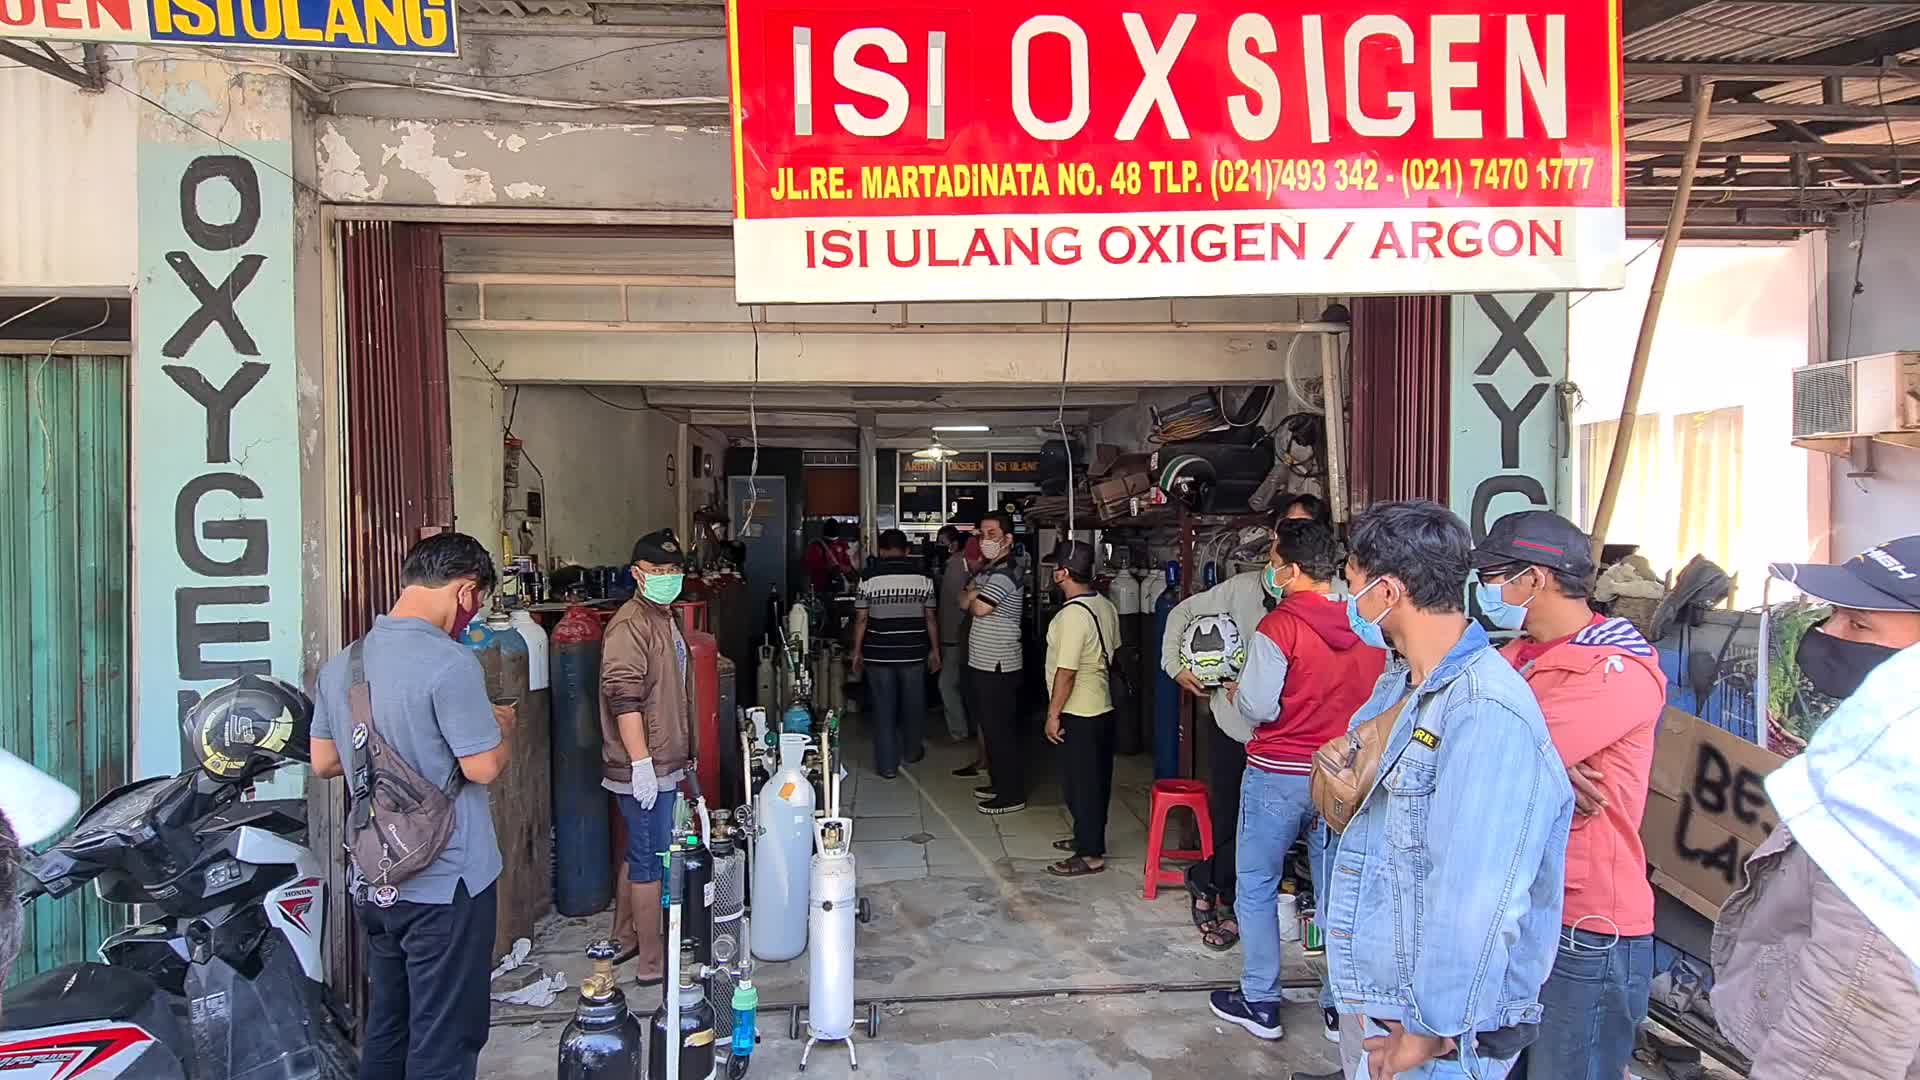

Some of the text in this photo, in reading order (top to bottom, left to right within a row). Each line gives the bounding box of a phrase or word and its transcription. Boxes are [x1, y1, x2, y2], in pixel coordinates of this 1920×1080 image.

[793, 26, 946, 140] ISI
[770, 166, 854, 200] JL.RE.
[862, 164, 1051, 198] MARTADINATA
[1058, 162, 1104, 195] NO.
[1111, 162, 1141, 194] 48
[1149, 160, 1202, 193] TLP.
[1335, 158, 1380, 191] 342
[1402, 158, 1462, 199] (021)
[1471, 158, 1529, 190] 7470
[1535, 158, 1595, 189] 1777
[806, 229, 870, 269] ISI
[886, 227, 1082, 269] ULANG
[1098, 222, 1306, 266] OXIGEN
[1370, 219, 1564, 260] ARGON
[1692, 739, 1773, 836] BE
[1675, 792, 1750, 883] LA
[285, 889, 312, 897] HONDA
